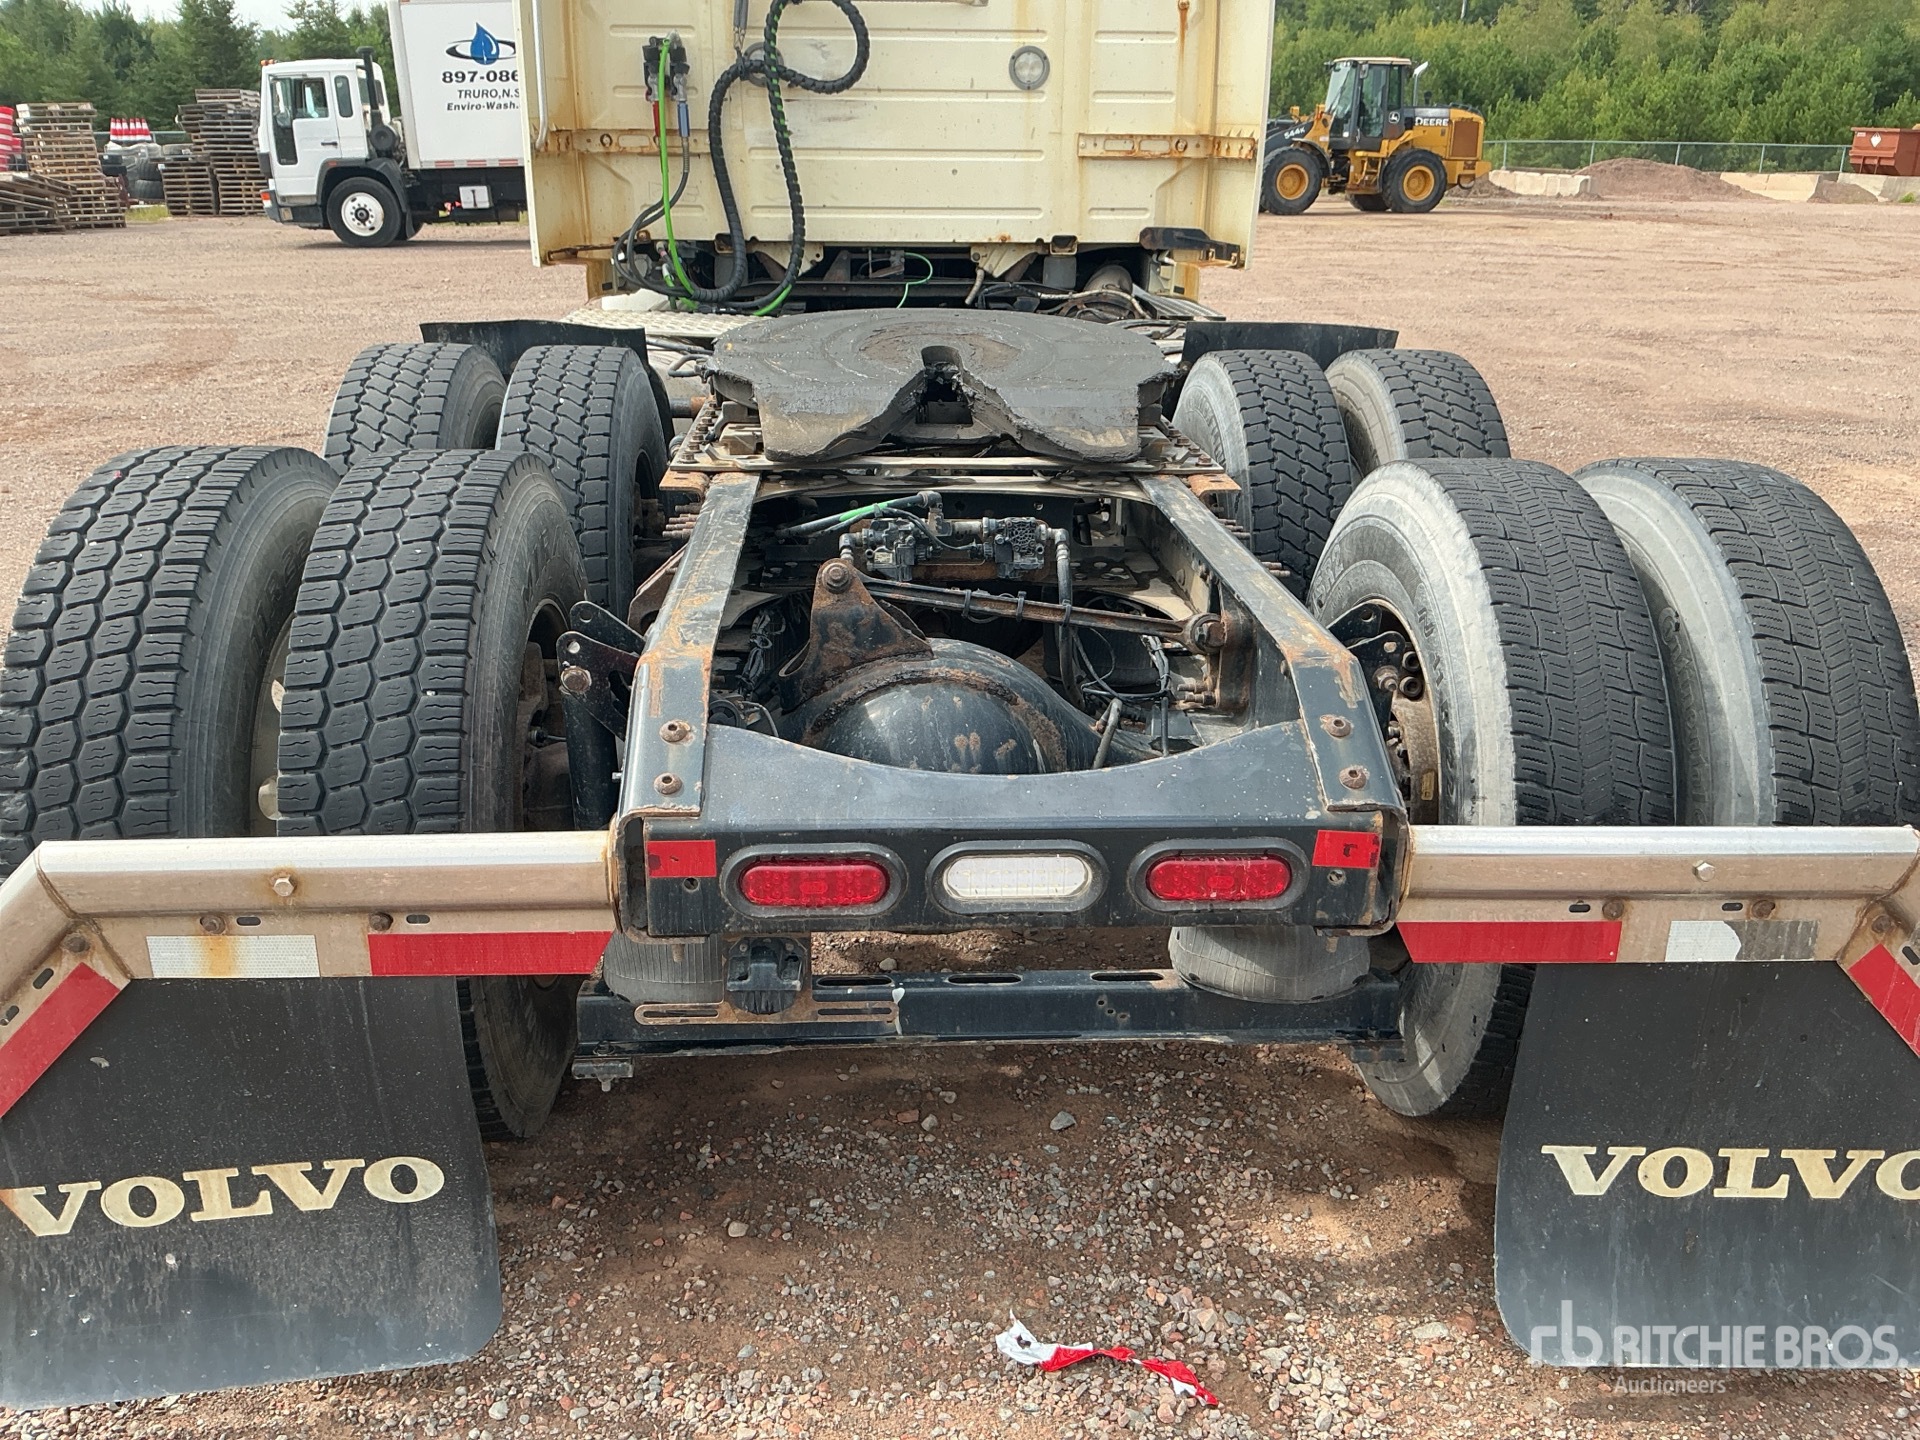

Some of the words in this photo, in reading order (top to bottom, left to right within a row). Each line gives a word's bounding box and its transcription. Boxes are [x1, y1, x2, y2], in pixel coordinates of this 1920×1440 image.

[446, 101, 519, 111] Enviro-Wash.
[1415, 116, 1449, 126] DEERE
[1541, 1145, 1920, 1200] VOLVO
[0, 1156, 445, 1237] VOLVO
